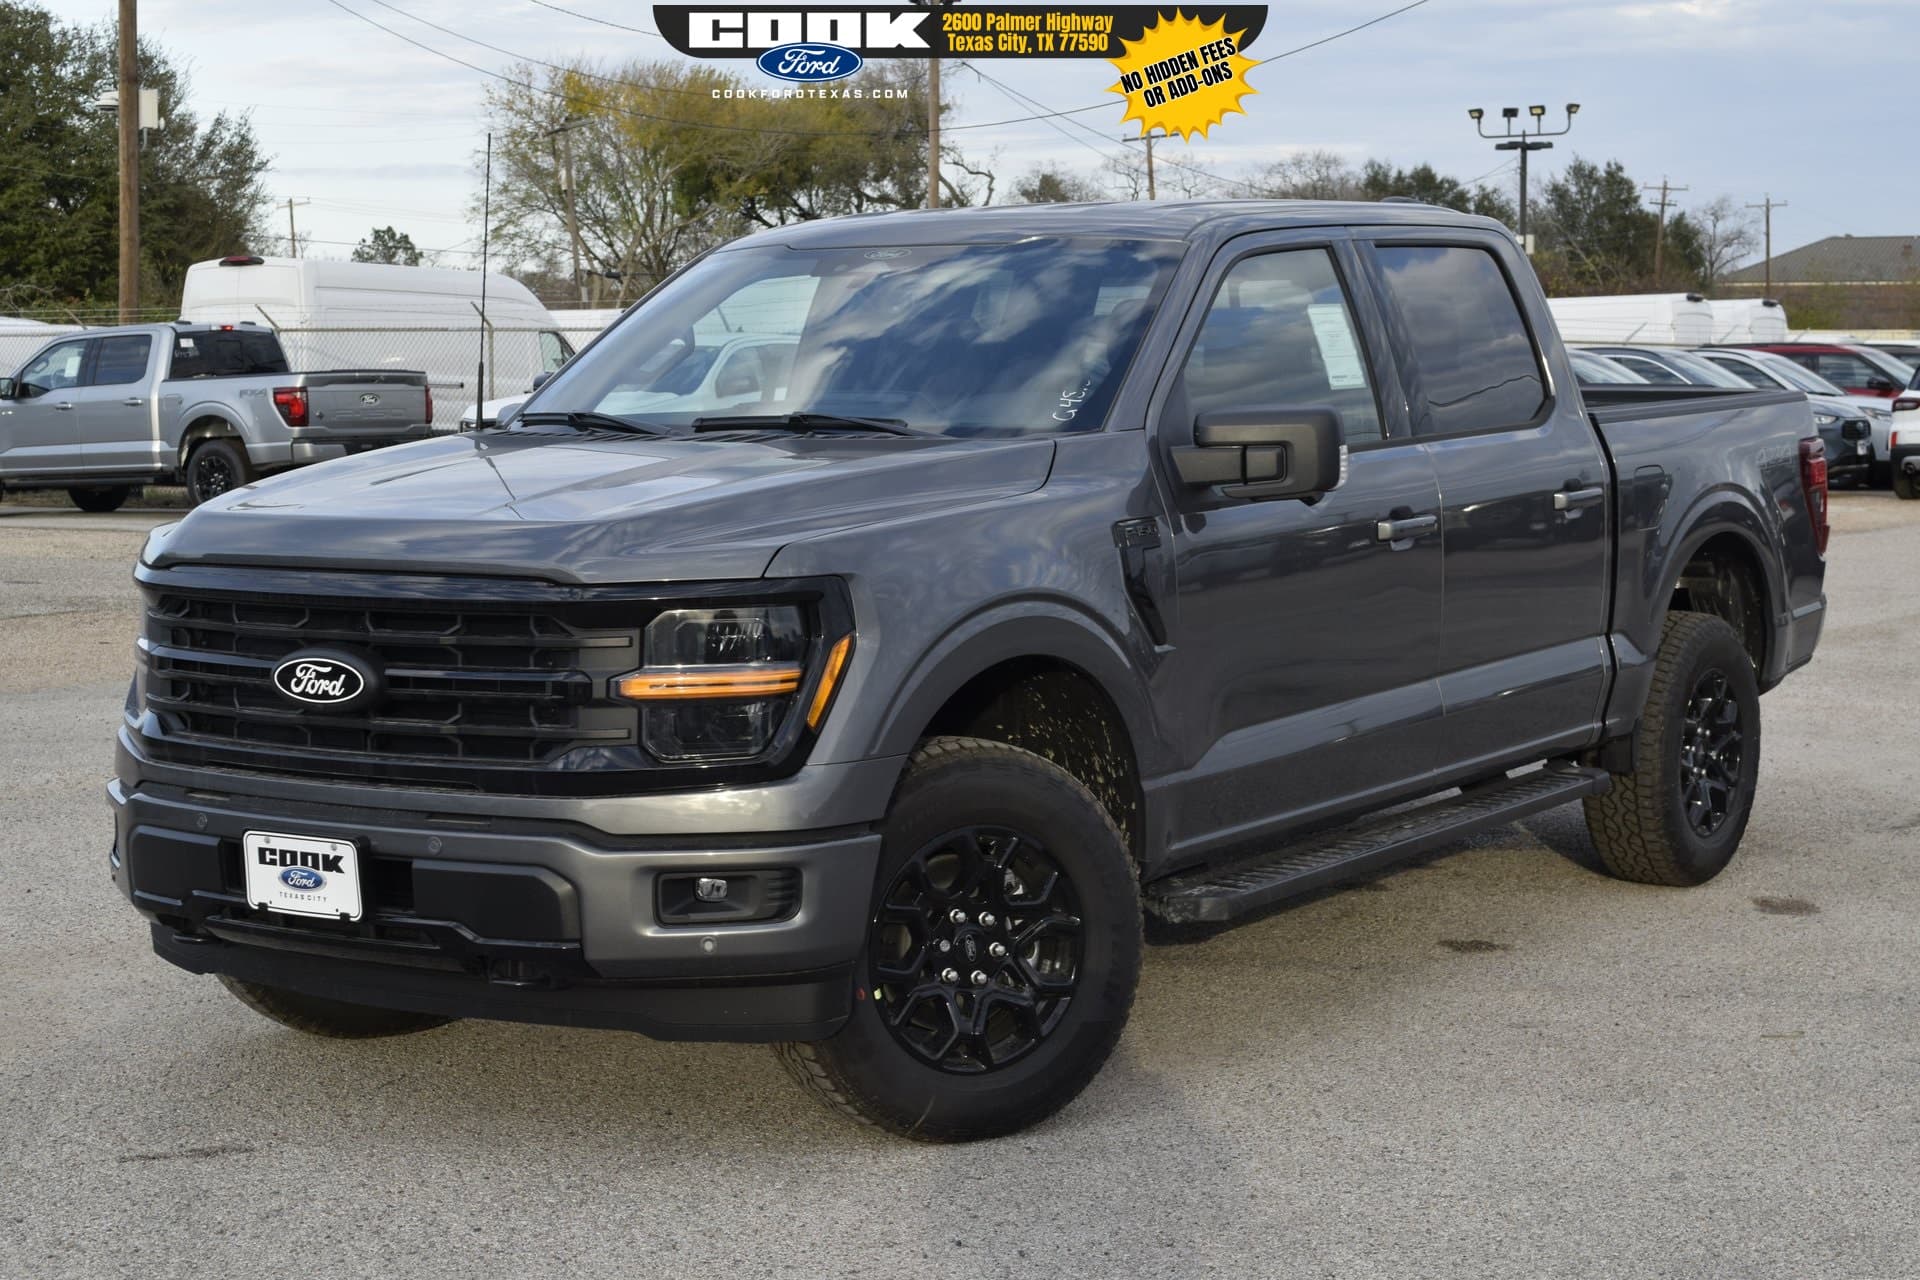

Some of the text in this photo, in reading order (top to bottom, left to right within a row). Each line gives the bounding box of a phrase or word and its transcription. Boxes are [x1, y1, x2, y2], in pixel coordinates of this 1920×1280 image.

[290, 663, 346, 697] Ford
[257, 846, 345, 874] COOK
[287, 870, 315, 888] Ford
[279, 891, 327, 903] TEXAS CITY
